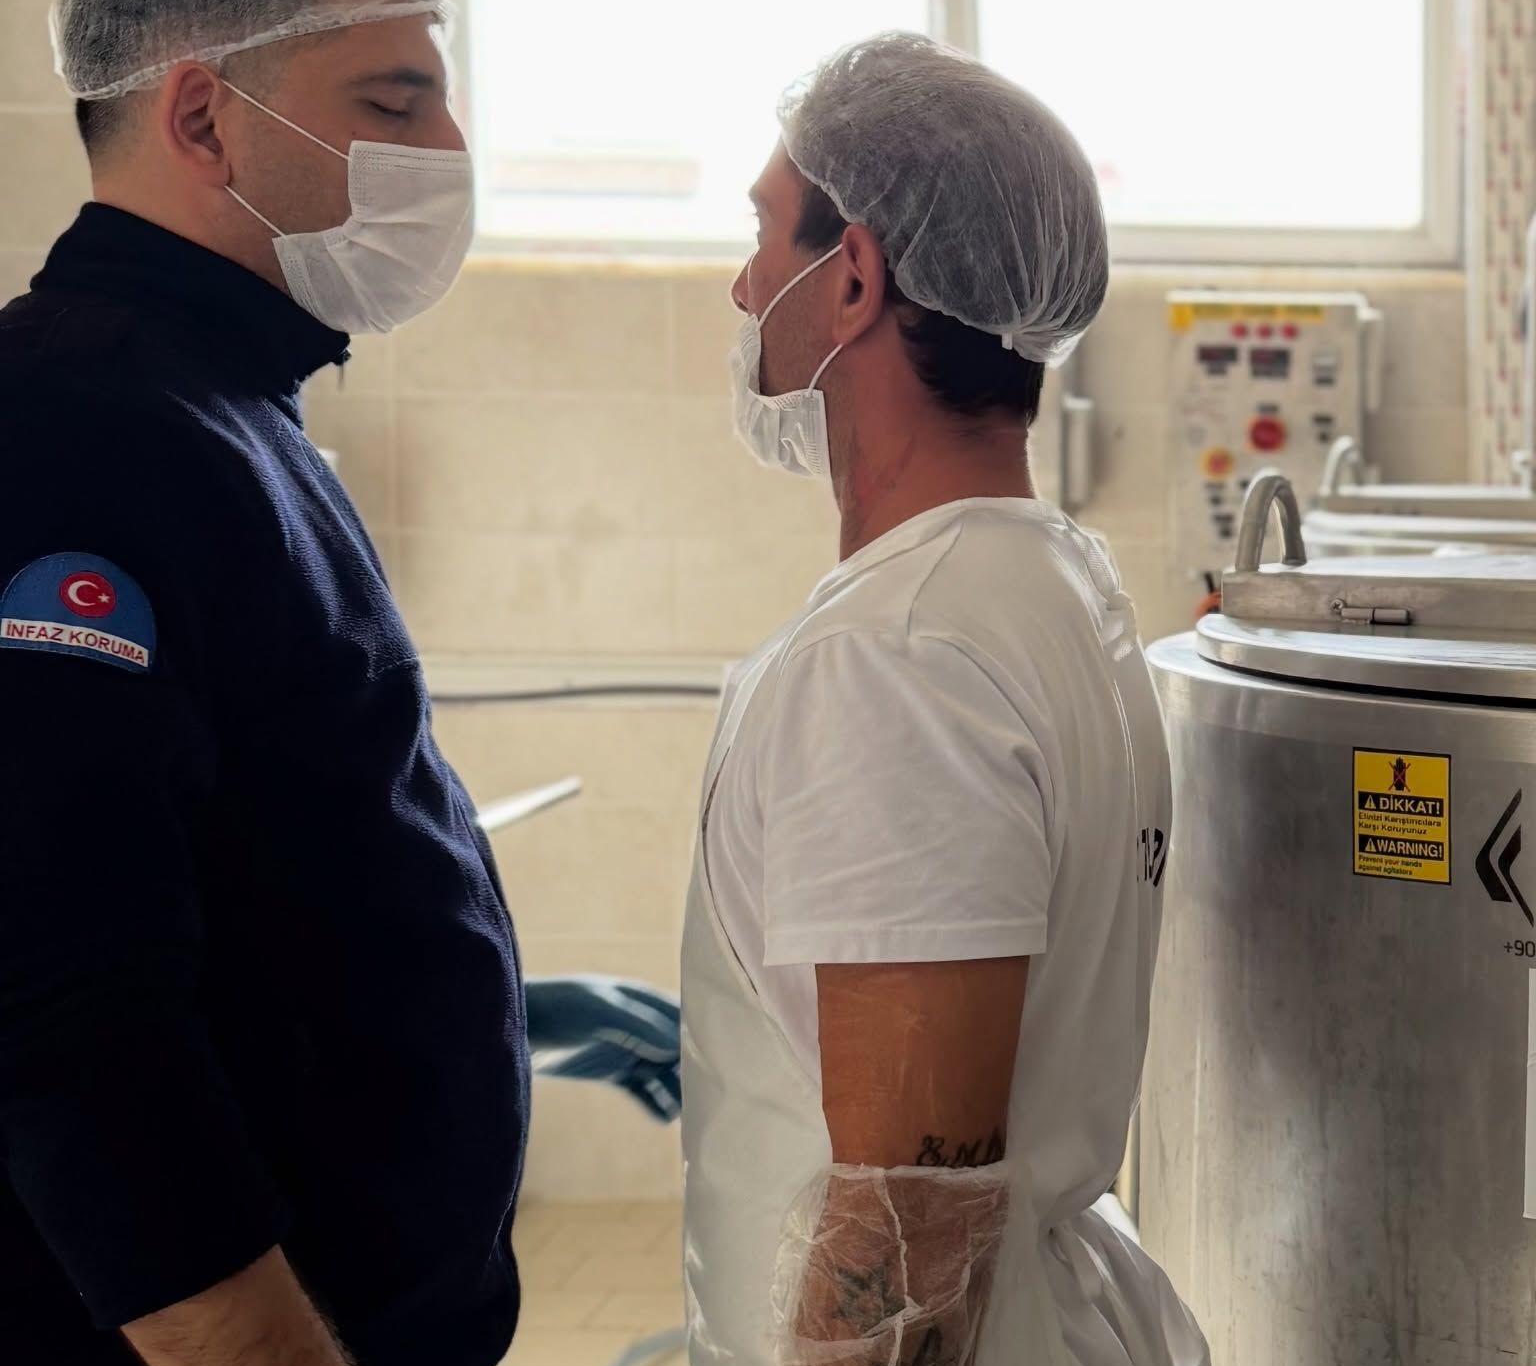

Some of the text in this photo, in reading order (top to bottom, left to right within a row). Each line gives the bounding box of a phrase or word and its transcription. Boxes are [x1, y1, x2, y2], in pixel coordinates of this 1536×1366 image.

[6, 620, 145, 664] İNFAZ KORUMA
[1379, 795, 1441, 815] DİKKAT!
[1377, 838, 1443, 858] WARNING!
[1503, 939, 1536, 958] +90
